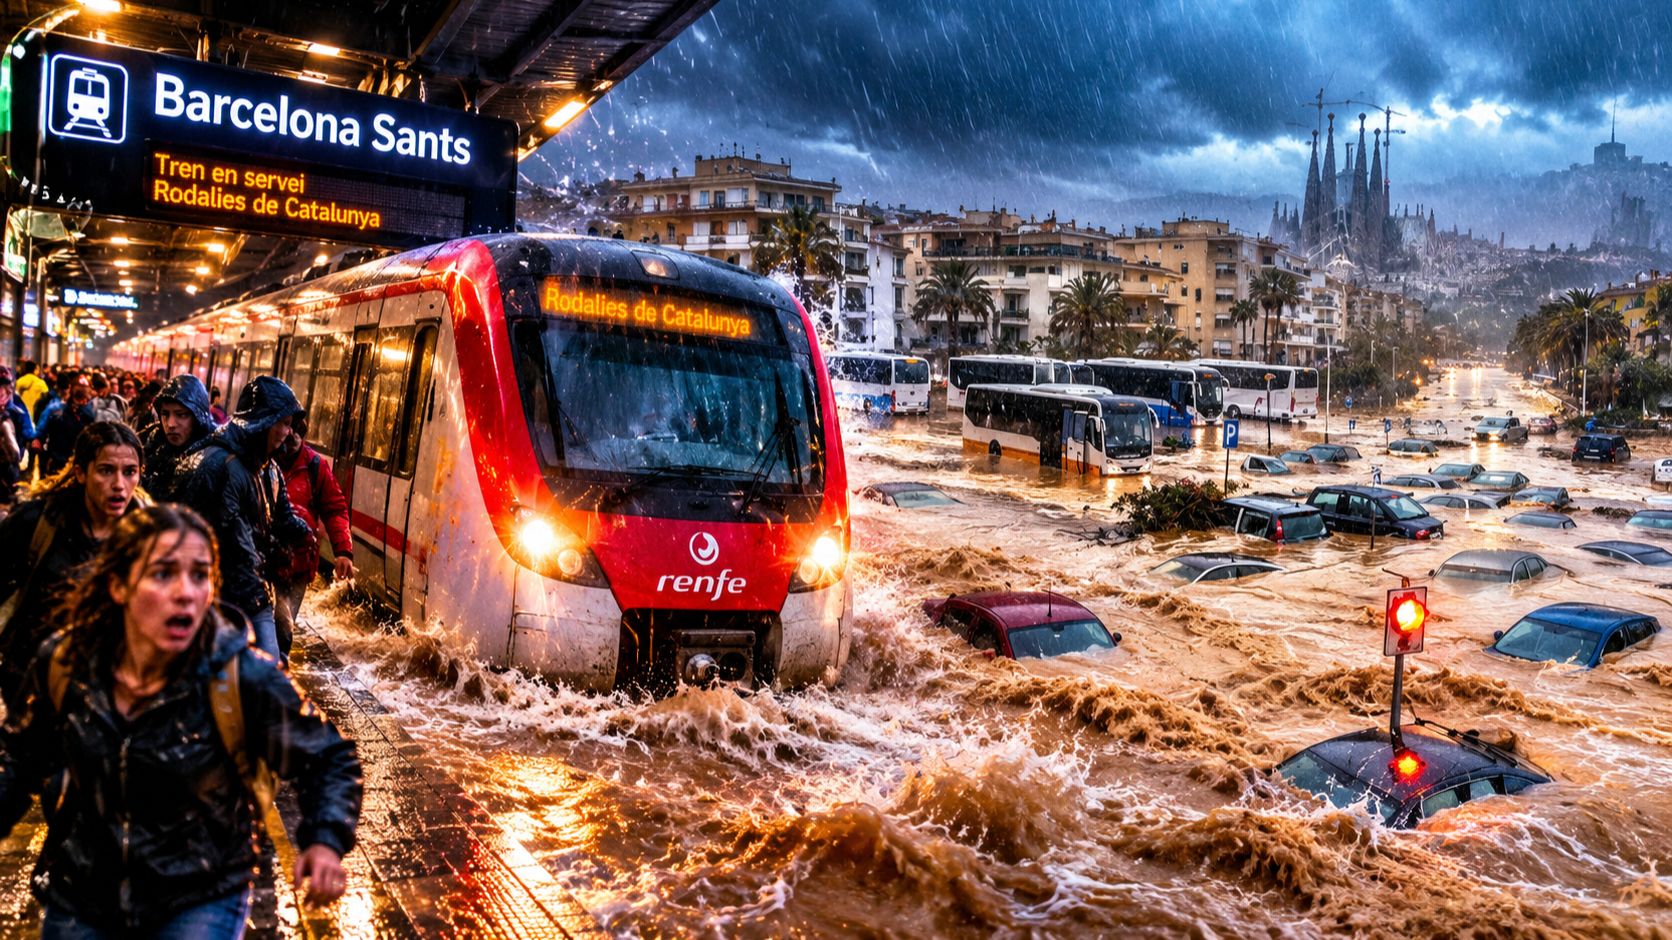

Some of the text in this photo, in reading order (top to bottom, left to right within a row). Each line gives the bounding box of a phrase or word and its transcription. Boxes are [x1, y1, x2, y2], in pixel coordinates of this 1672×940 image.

[155, 73, 471, 165] Barcelona Sants
[154, 152, 305, 194] Tren en servei
[153, 179, 381, 230] Rodalies de Catalunya
[544, 286, 750, 338] Rodalies de Catalunya
[1226, 424, 1236, 446] P
[656, 568, 747, 602] renfe
